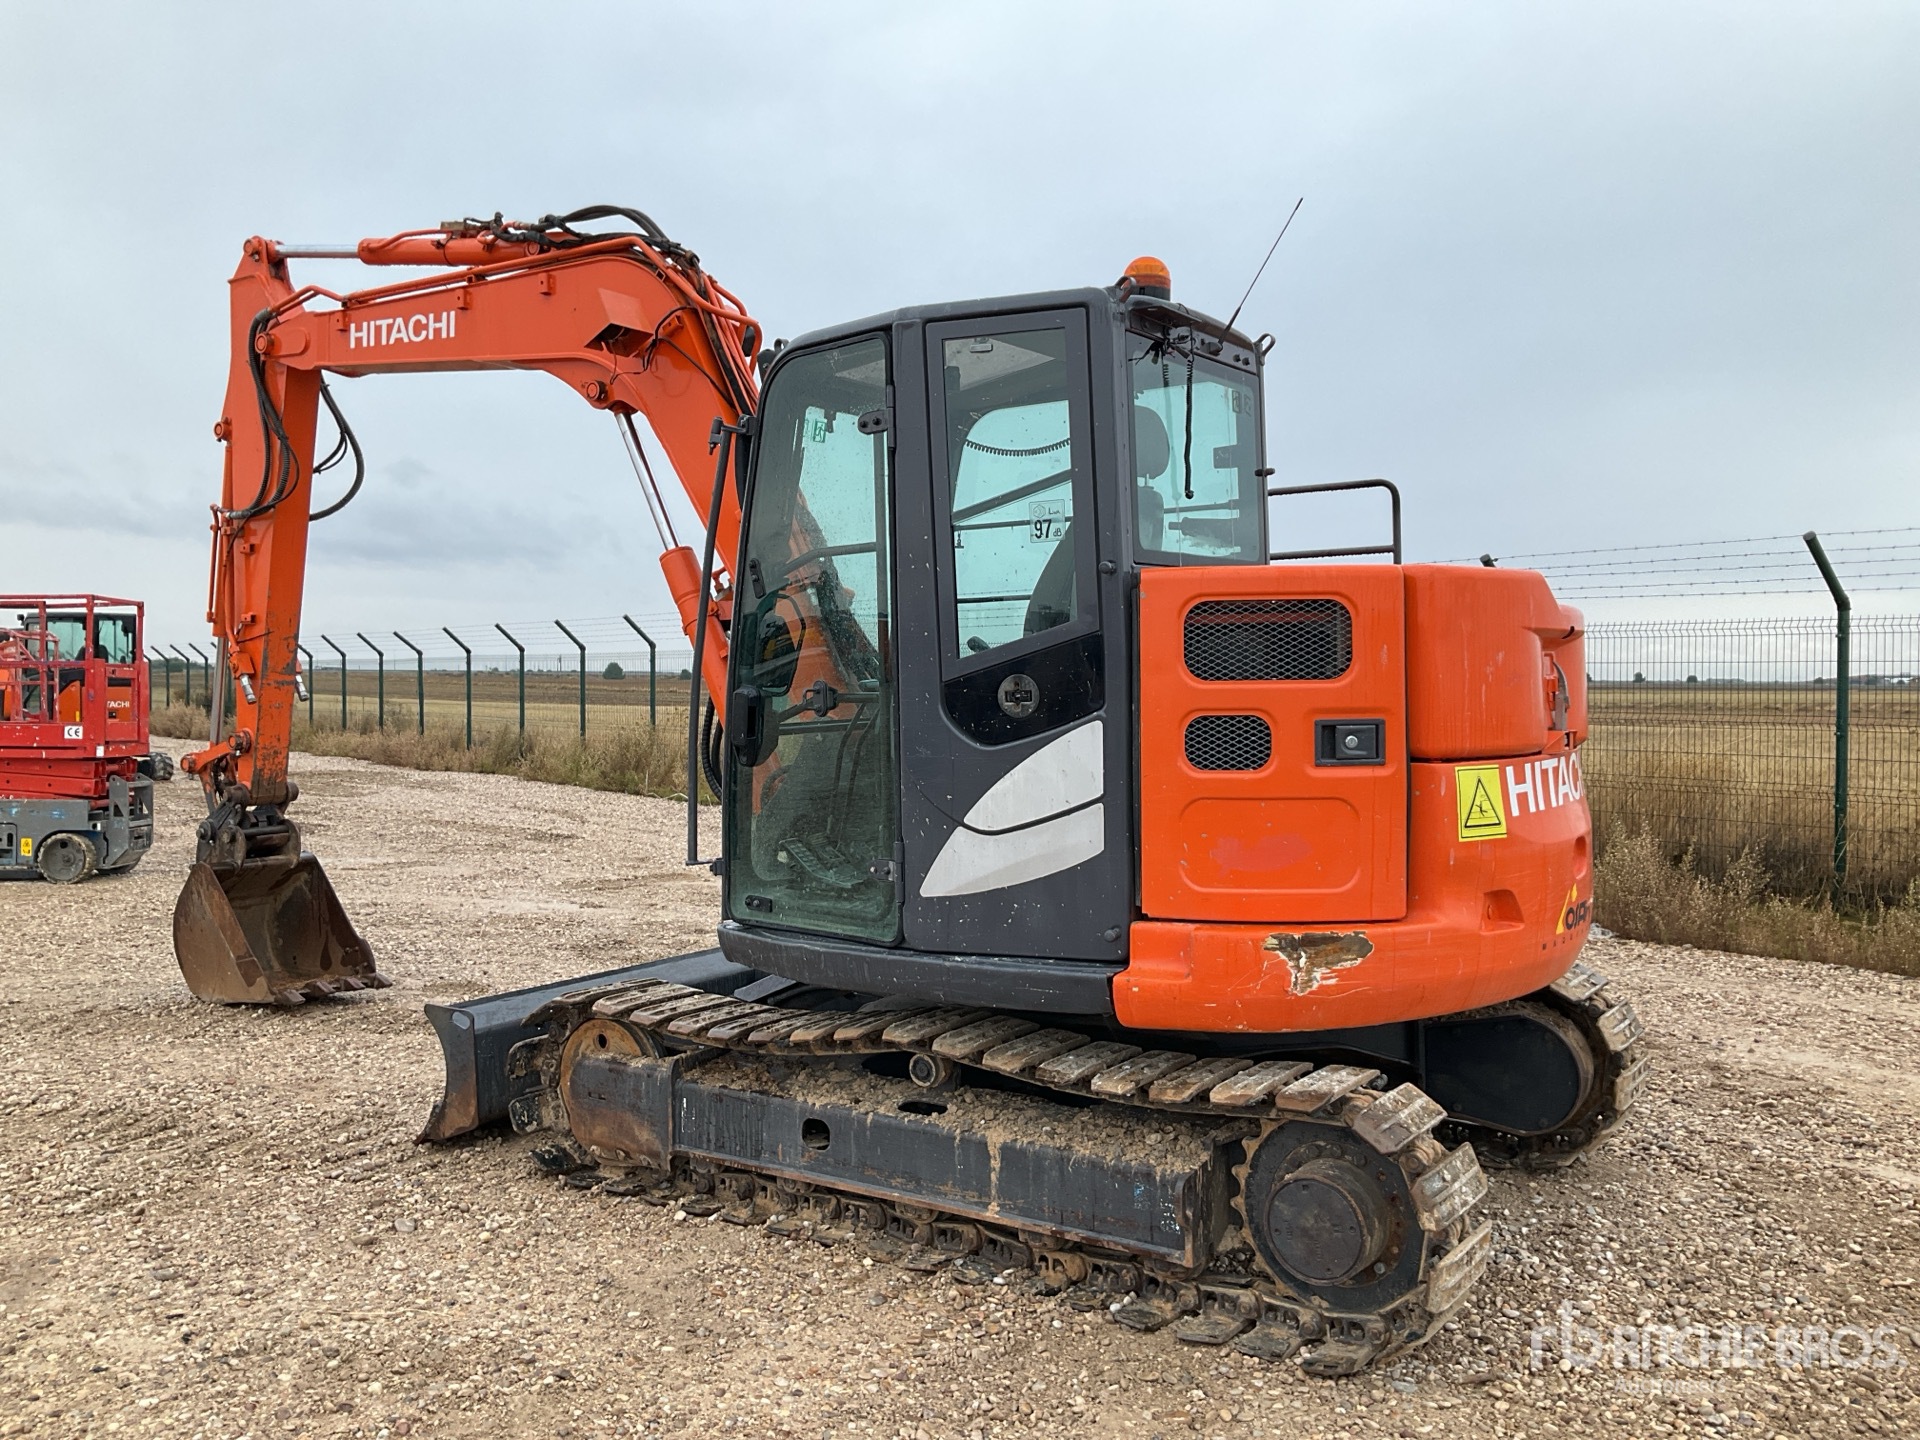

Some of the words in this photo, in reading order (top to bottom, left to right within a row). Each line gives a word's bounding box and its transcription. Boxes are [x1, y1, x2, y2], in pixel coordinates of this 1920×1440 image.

[349, 310, 456, 349] HITACHI
[1034, 518, 1052, 539] 97
[1053, 527, 1062, 537] dB
[67, 727, 80, 737] CE
[1506, 752, 1584, 817] HITAC
